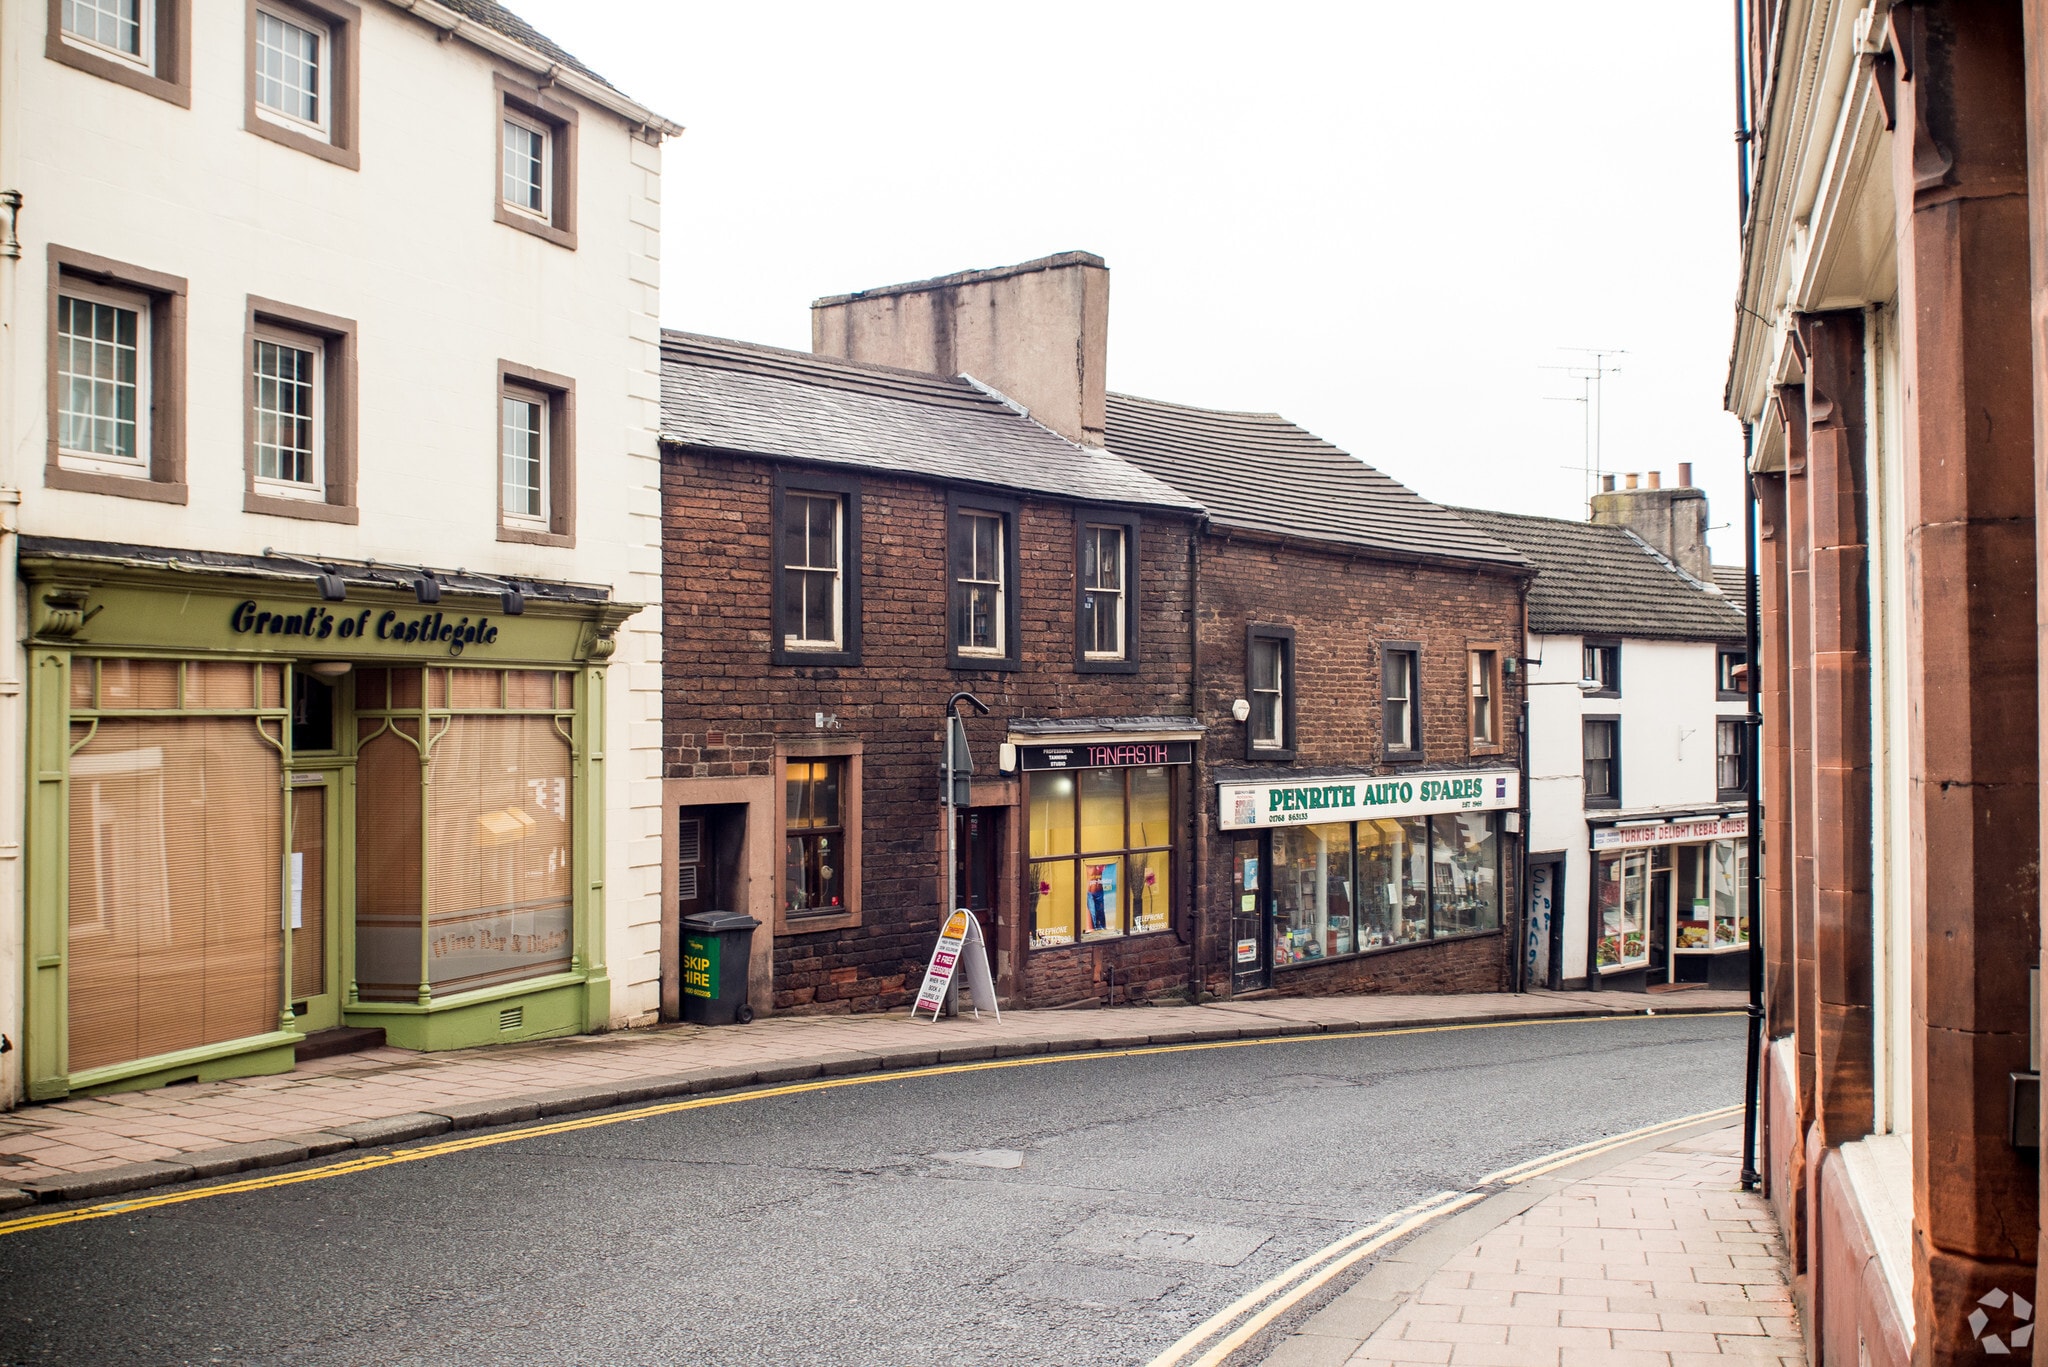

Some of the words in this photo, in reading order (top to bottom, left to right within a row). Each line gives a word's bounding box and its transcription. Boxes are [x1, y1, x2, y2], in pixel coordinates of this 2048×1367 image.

[231, 600, 334, 639] Grant's
[338, 609, 371, 638] of
[377, 610, 498, 656] Castlegate
[1087, 744, 1168, 766] TANFASTIK
[1268, 785, 1356, 812] PENRITH
[1362, 781, 1413, 806] AUTO
[1419, 777, 1482, 802] SPARES
[1620, 828, 1656, 843] TURKISH
[1658, 824, 1690, 840] DELIGHT
[1693, 822, 1718, 836] KEBAB
[1721, 820, 1745, 834] HOUSE
[1135, 913, 1165, 923] TELEPHONE
[1035, 925, 1068, 936] TELEPHONE
[432, 933, 476, 958] Wine
[479, 929, 507, 952] Bar
[511, 934, 522, 953] &
[526, 928, 569, 954] Bistro
[684, 955, 710, 971] SKIP
[936, 954, 942, 963] 2
[941, 955, 955, 966] FREE
[684, 970, 710, 987] HIRE
[929, 977, 939, 985] WHEN
[928, 984, 938, 993] BOOK
